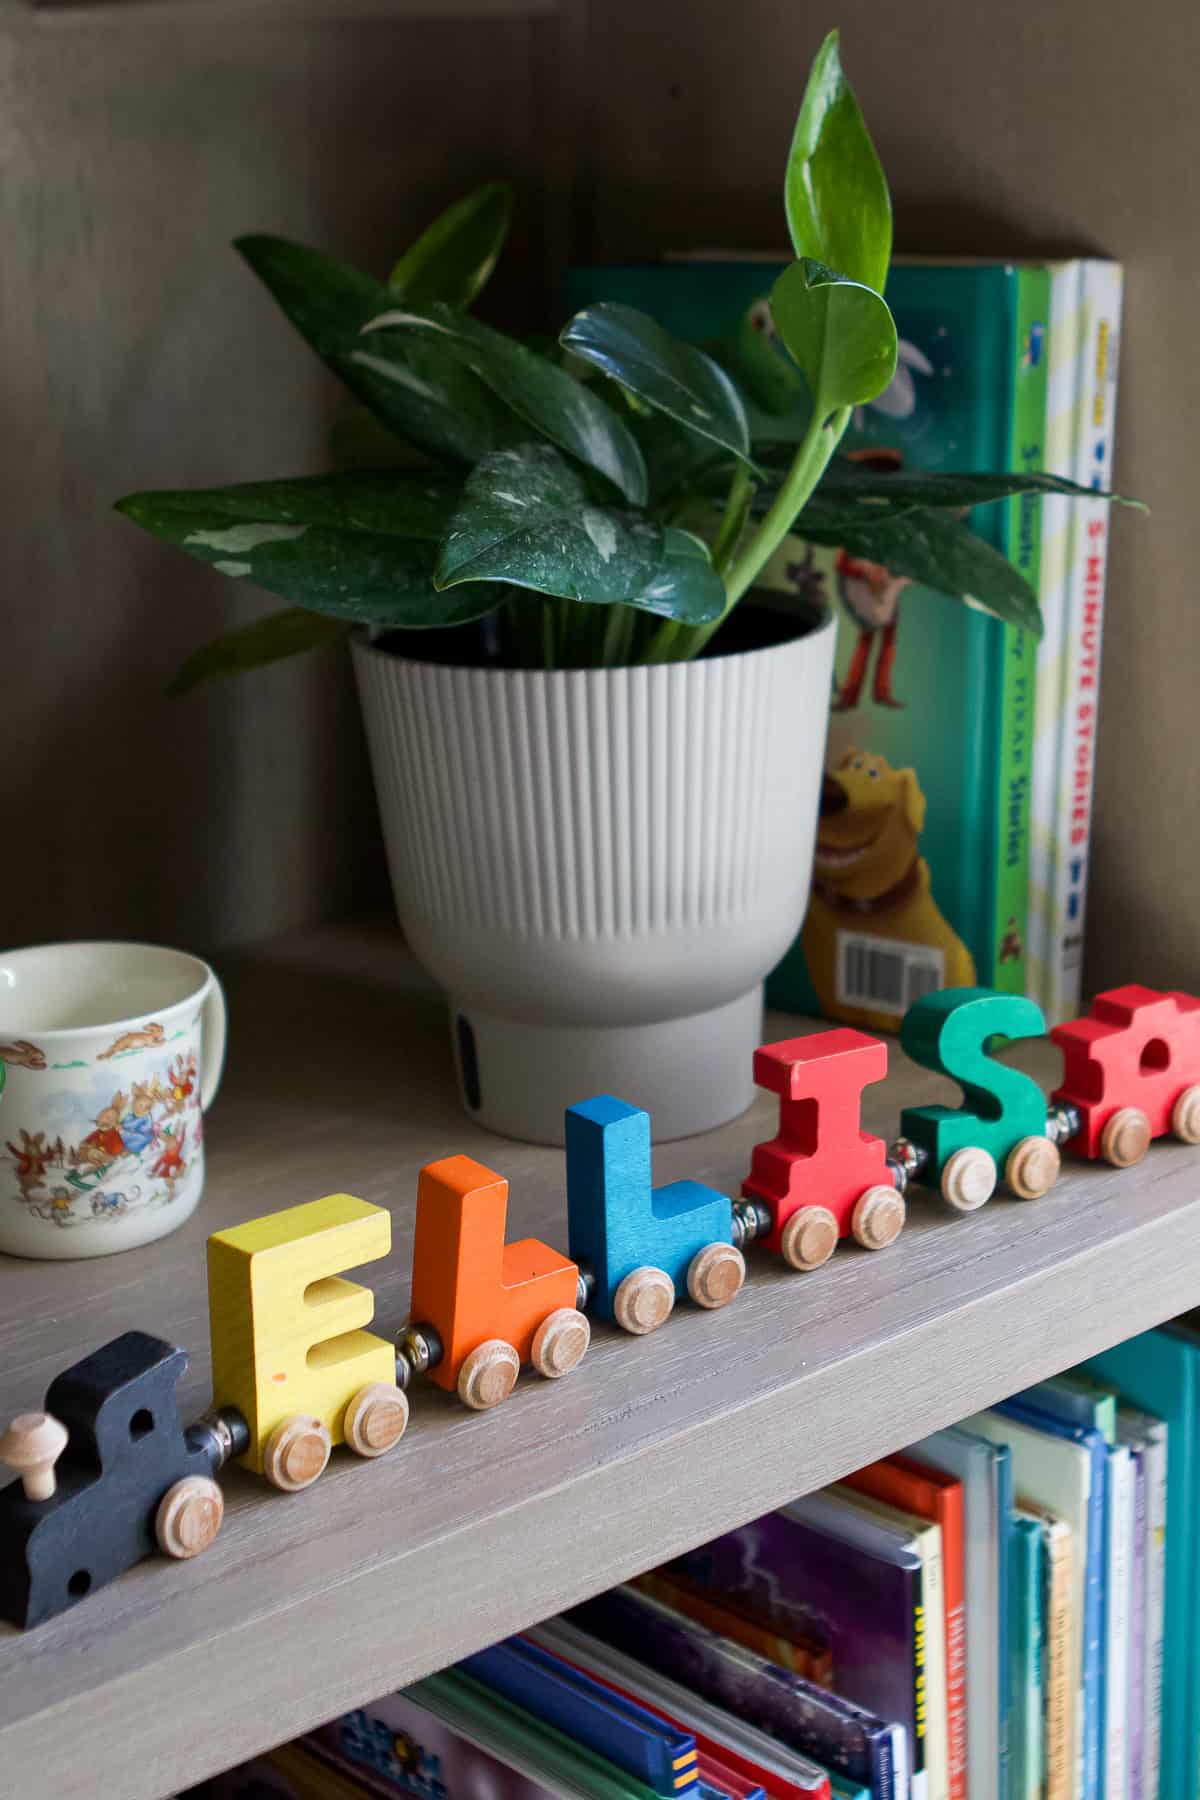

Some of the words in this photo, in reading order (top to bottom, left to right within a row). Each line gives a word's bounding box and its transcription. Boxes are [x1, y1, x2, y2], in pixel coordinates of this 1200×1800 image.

[1006, 776, 1030, 866] Stories
[1070, 703, 1093, 846] STORIES
[208, 987, 1058, 1482] ELLIS
